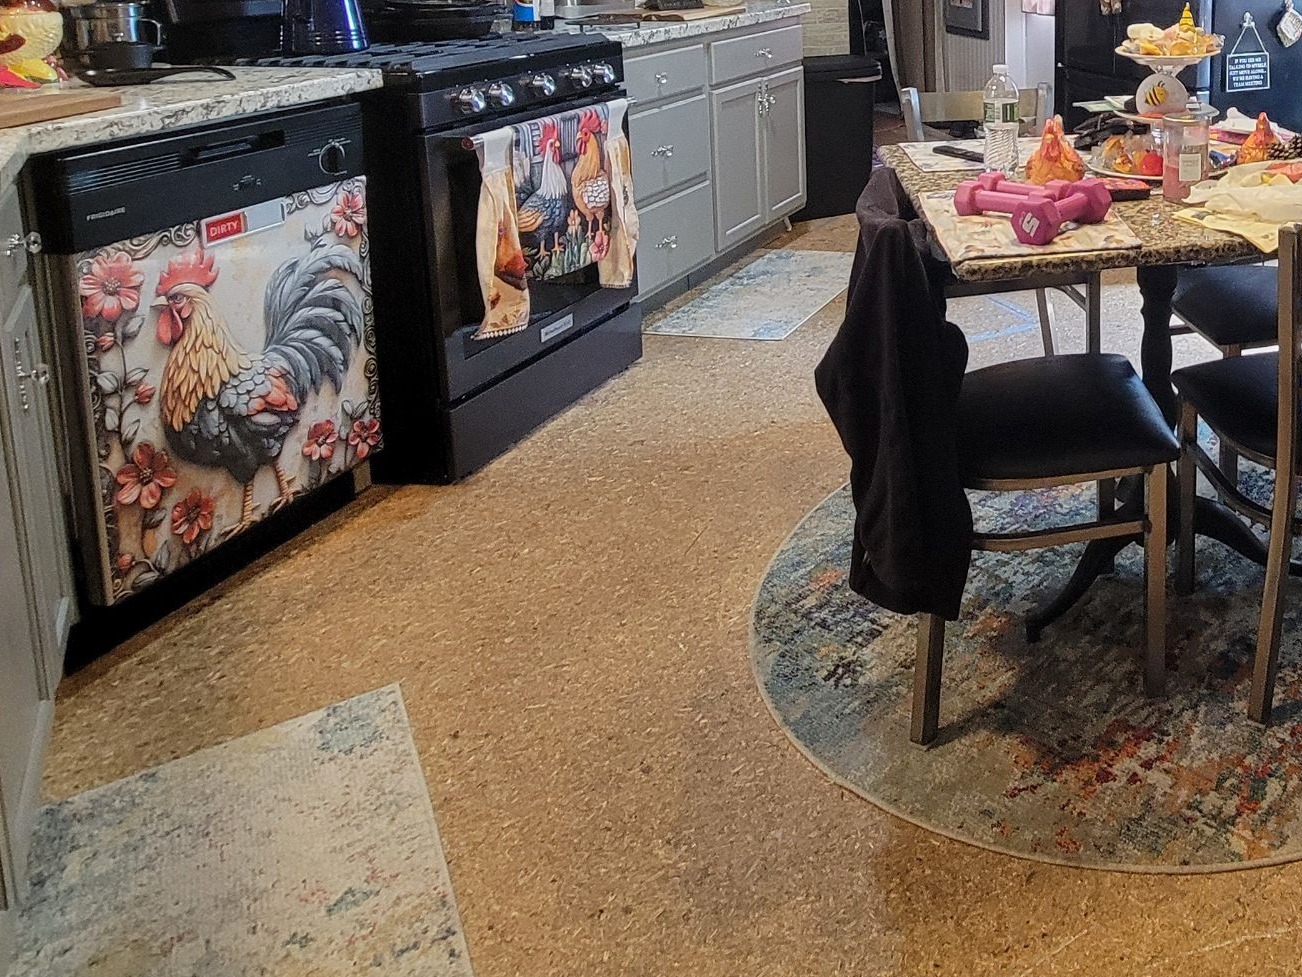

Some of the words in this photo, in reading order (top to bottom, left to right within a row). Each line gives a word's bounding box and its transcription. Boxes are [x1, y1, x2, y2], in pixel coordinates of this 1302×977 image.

[86, 206, 126, 222] FRIGIDAIRE
[209, 220, 239, 238] DIRTY
[1022, 212, 1040, 238] 5
